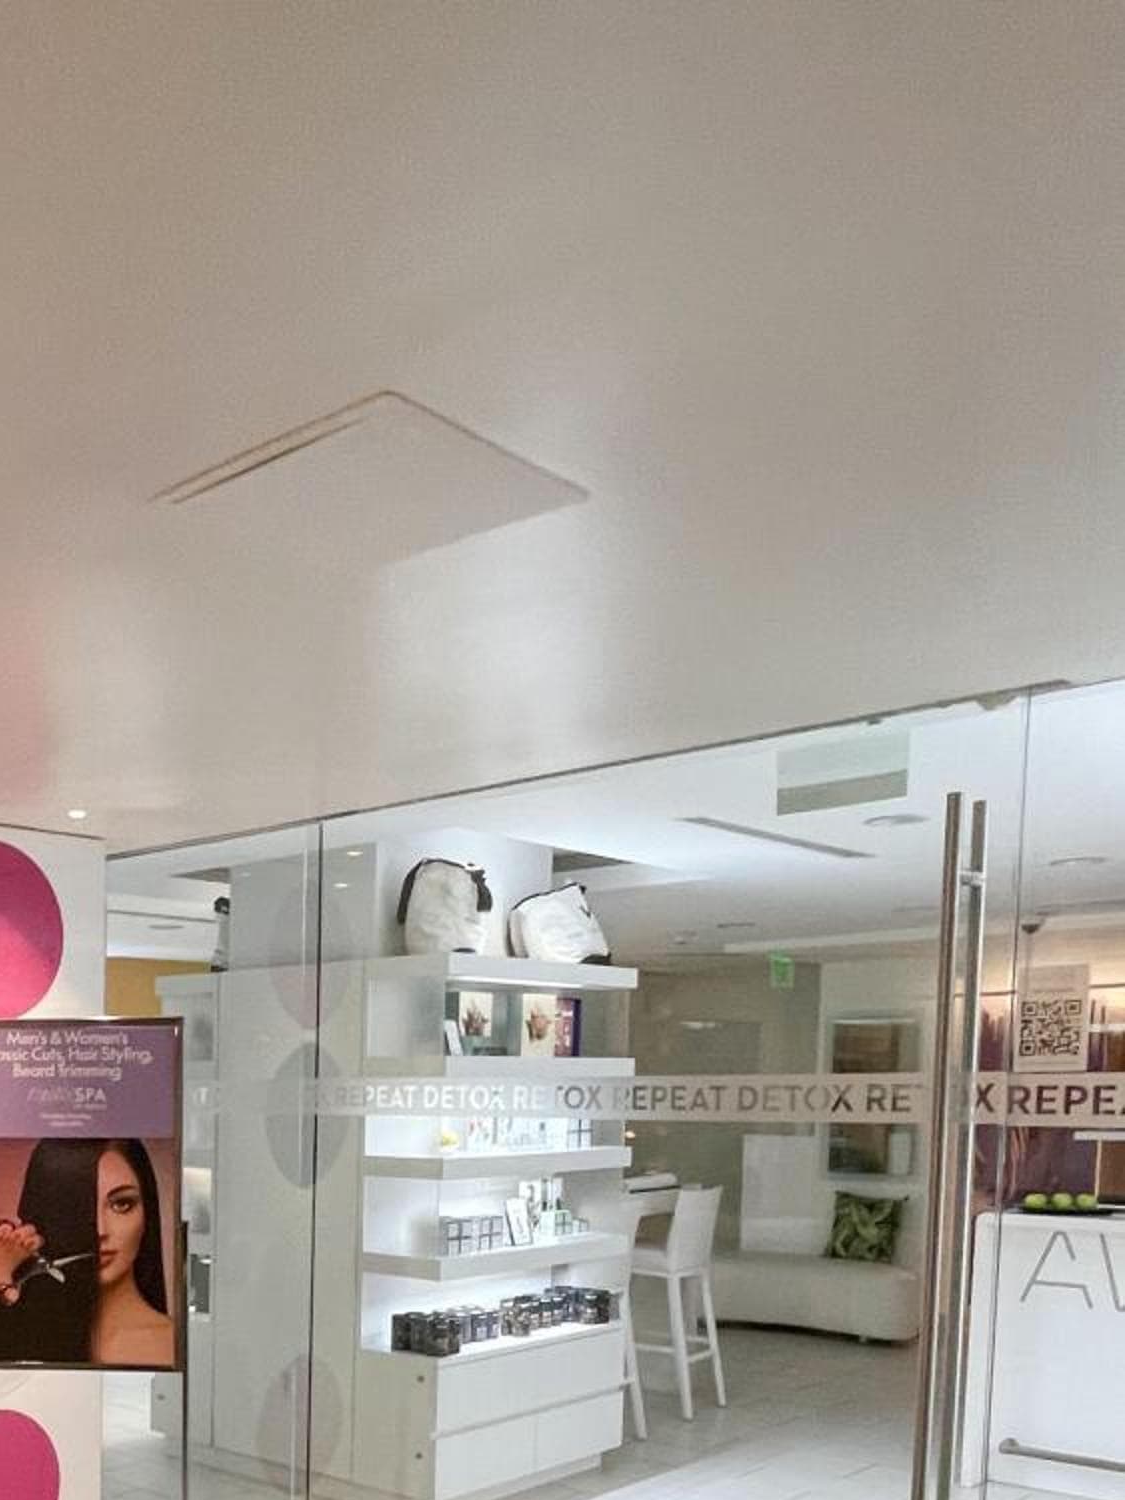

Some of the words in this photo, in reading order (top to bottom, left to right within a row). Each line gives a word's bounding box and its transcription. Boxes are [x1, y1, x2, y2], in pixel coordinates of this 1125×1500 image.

[6, 1031, 48, 1046] Men's
[50, 1031, 62, 1045] &
[64, 1030, 129, 1046] Women's
[67, 1047, 98, 1062] Hair
[12, 1063, 56, 1078] Beard
[57, 1063, 123, 1082] Trimming
[425, 1086, 507, 1110] DETOX
[737, 1084, 853, 1113] DETOX
[1007, 1085, 1125, 1115] REPE
